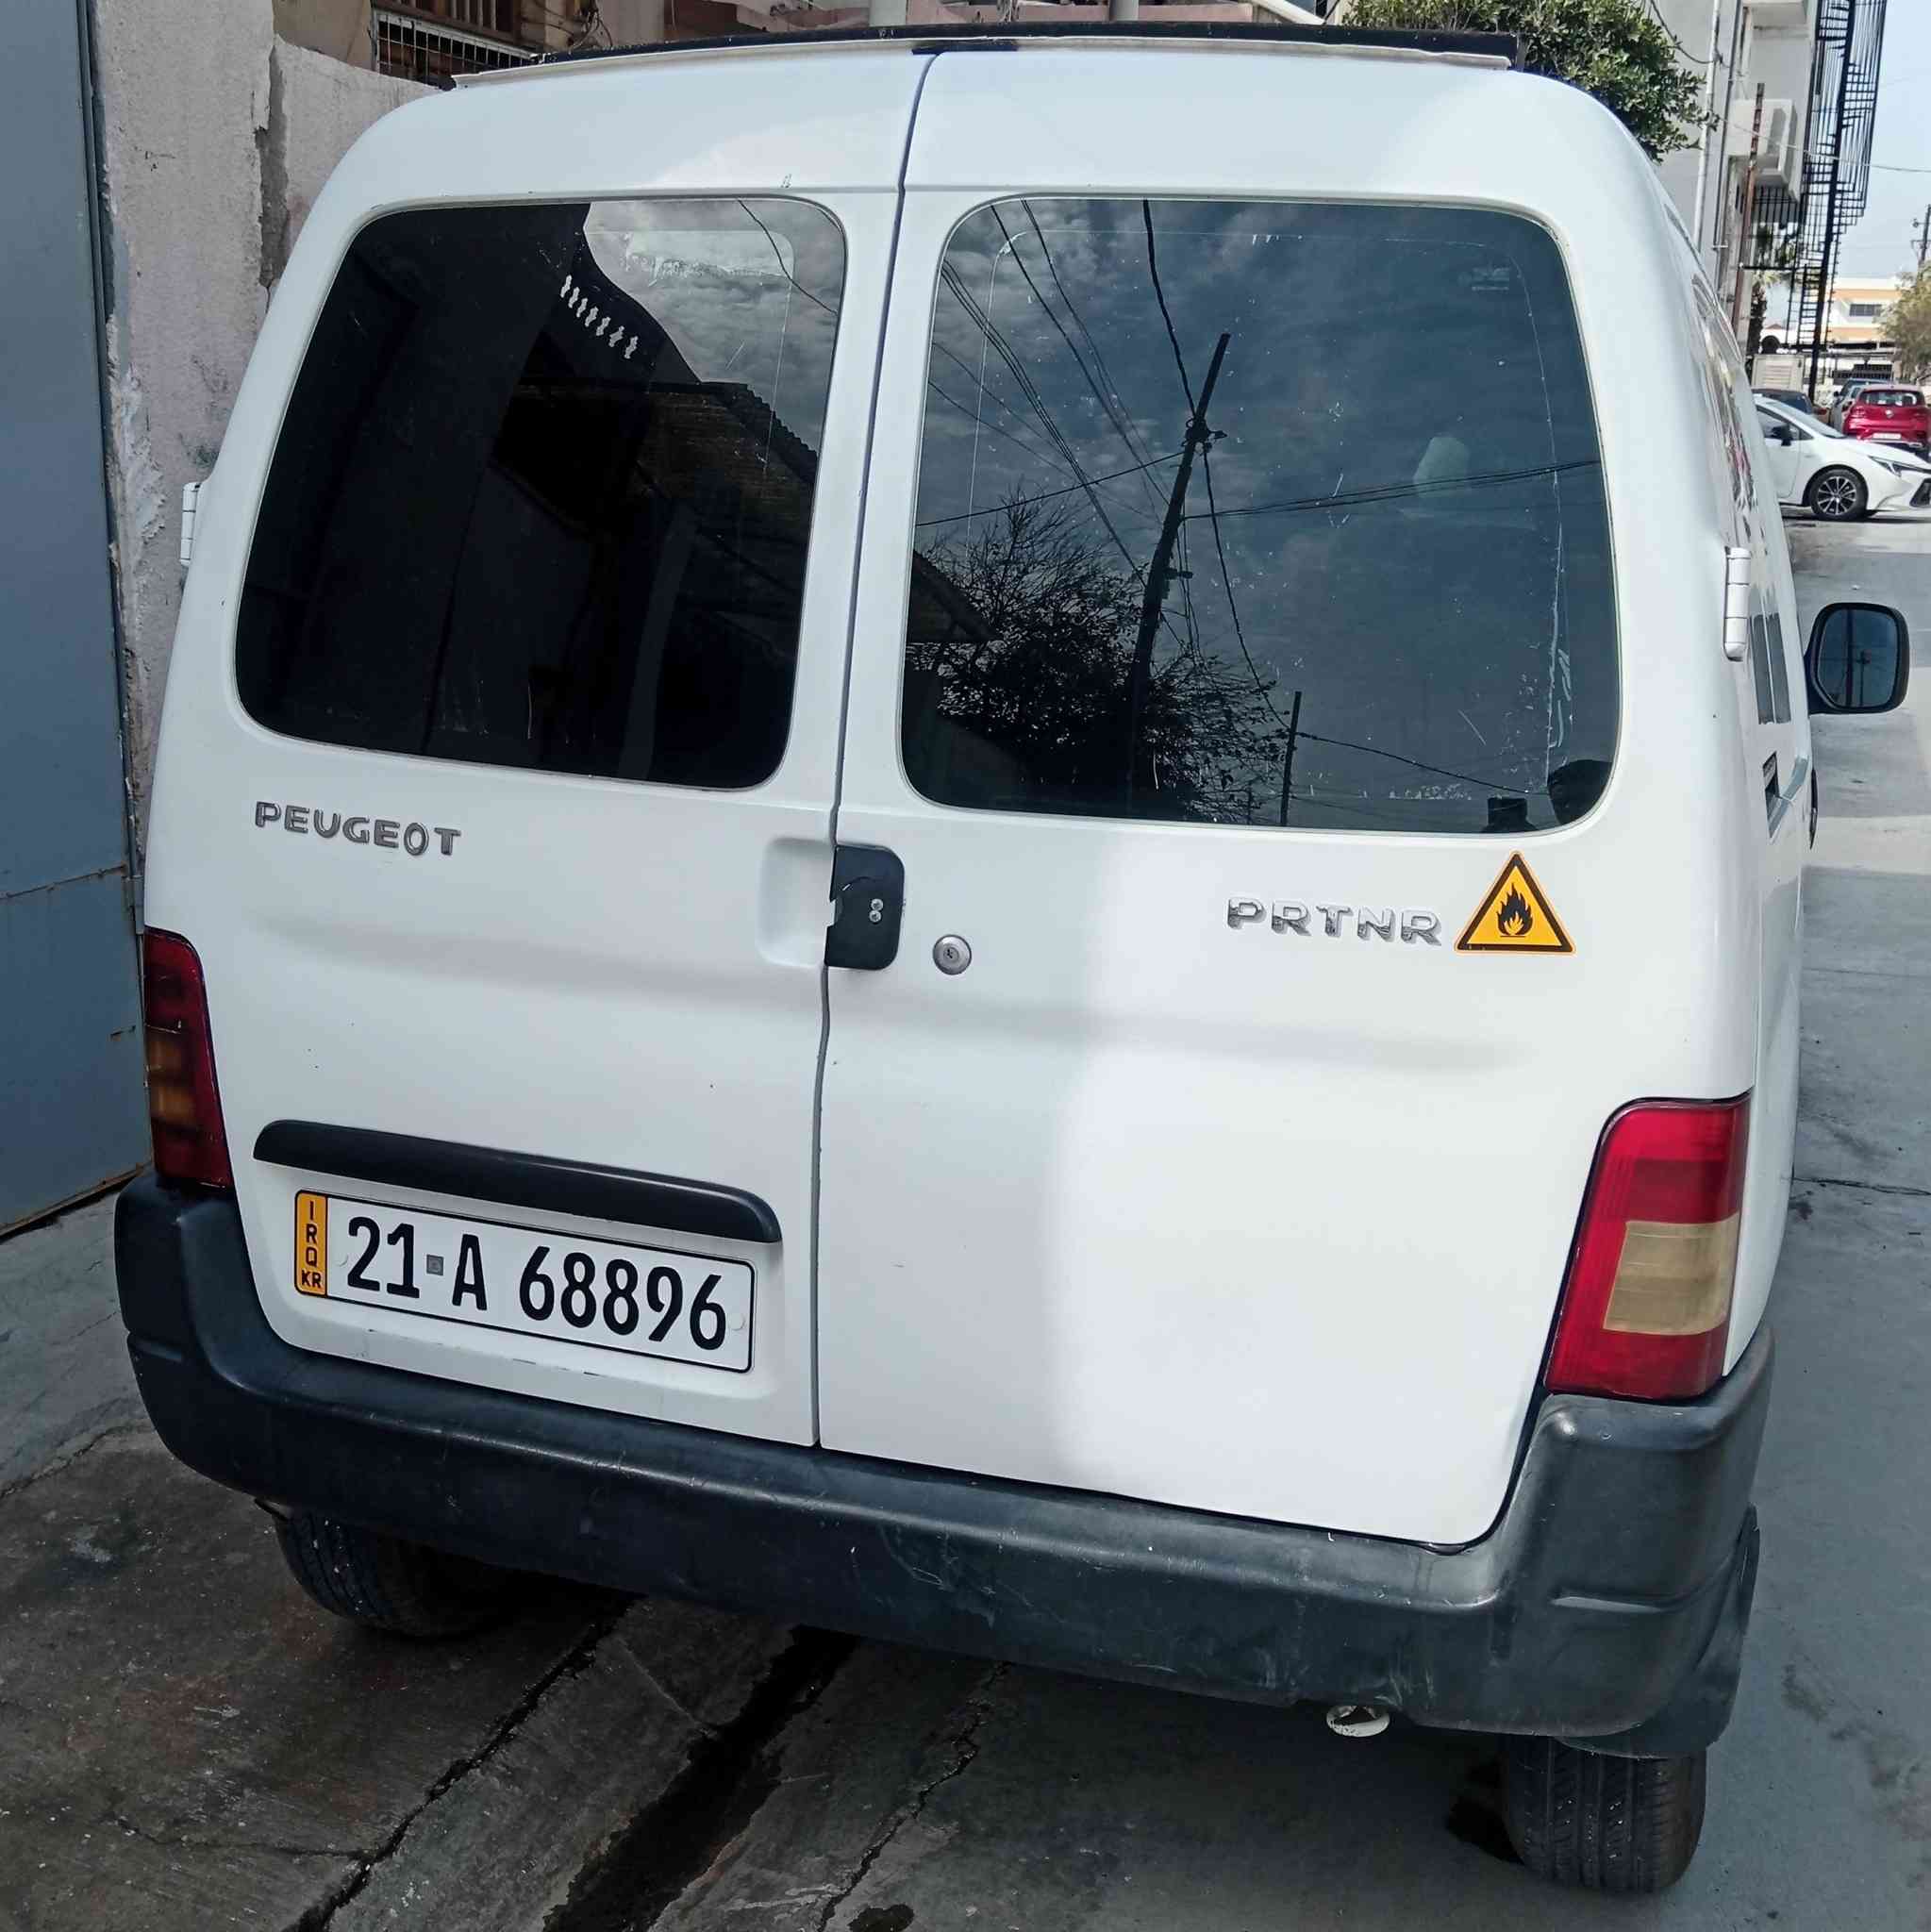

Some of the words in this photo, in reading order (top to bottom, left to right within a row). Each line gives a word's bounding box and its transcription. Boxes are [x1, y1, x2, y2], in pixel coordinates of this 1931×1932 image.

[255, 800, 462, 857] PEUGEOT
[1227, 896, 1442, 947] PRTNR
[301, 1269, 323, 1289] KR
[518, 1245, 727, 1352] 68896
